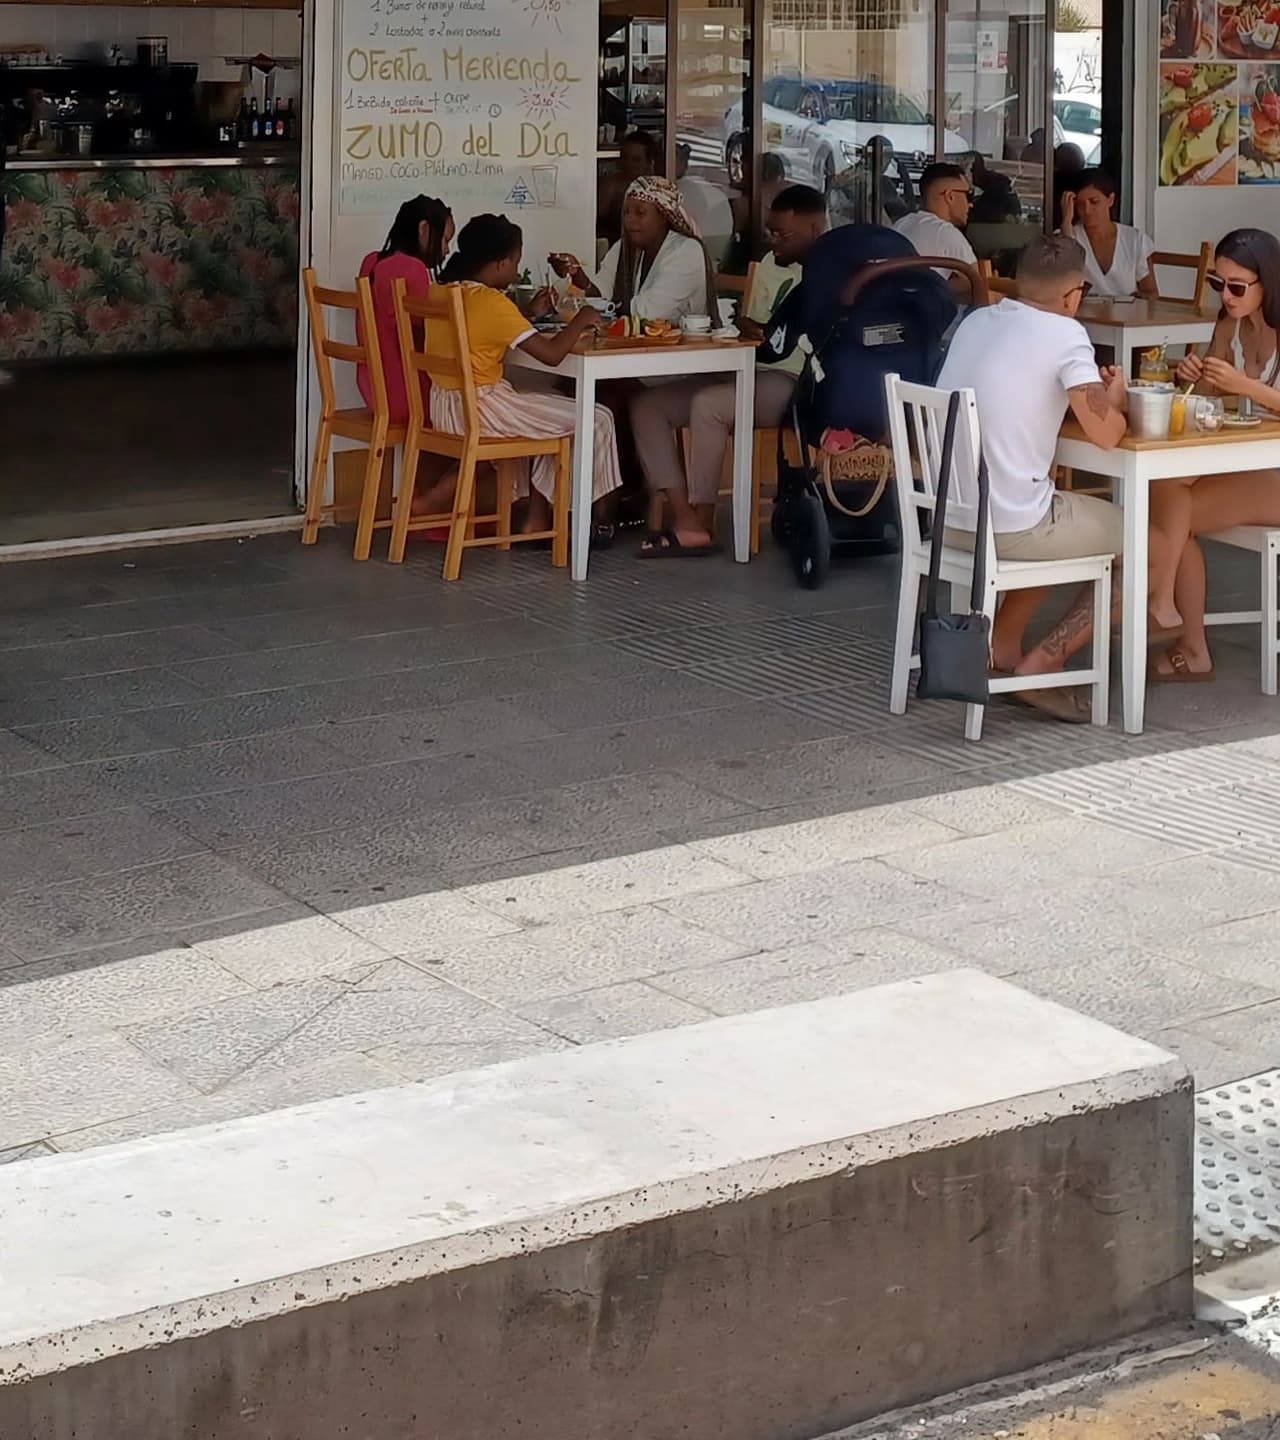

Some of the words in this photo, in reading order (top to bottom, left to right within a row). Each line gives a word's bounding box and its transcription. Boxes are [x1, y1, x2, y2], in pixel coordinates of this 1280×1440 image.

[345, 120, 443, 160] ZUMO
[462, 120, 500, 157] del
[516, 120, 578, 158] Día
